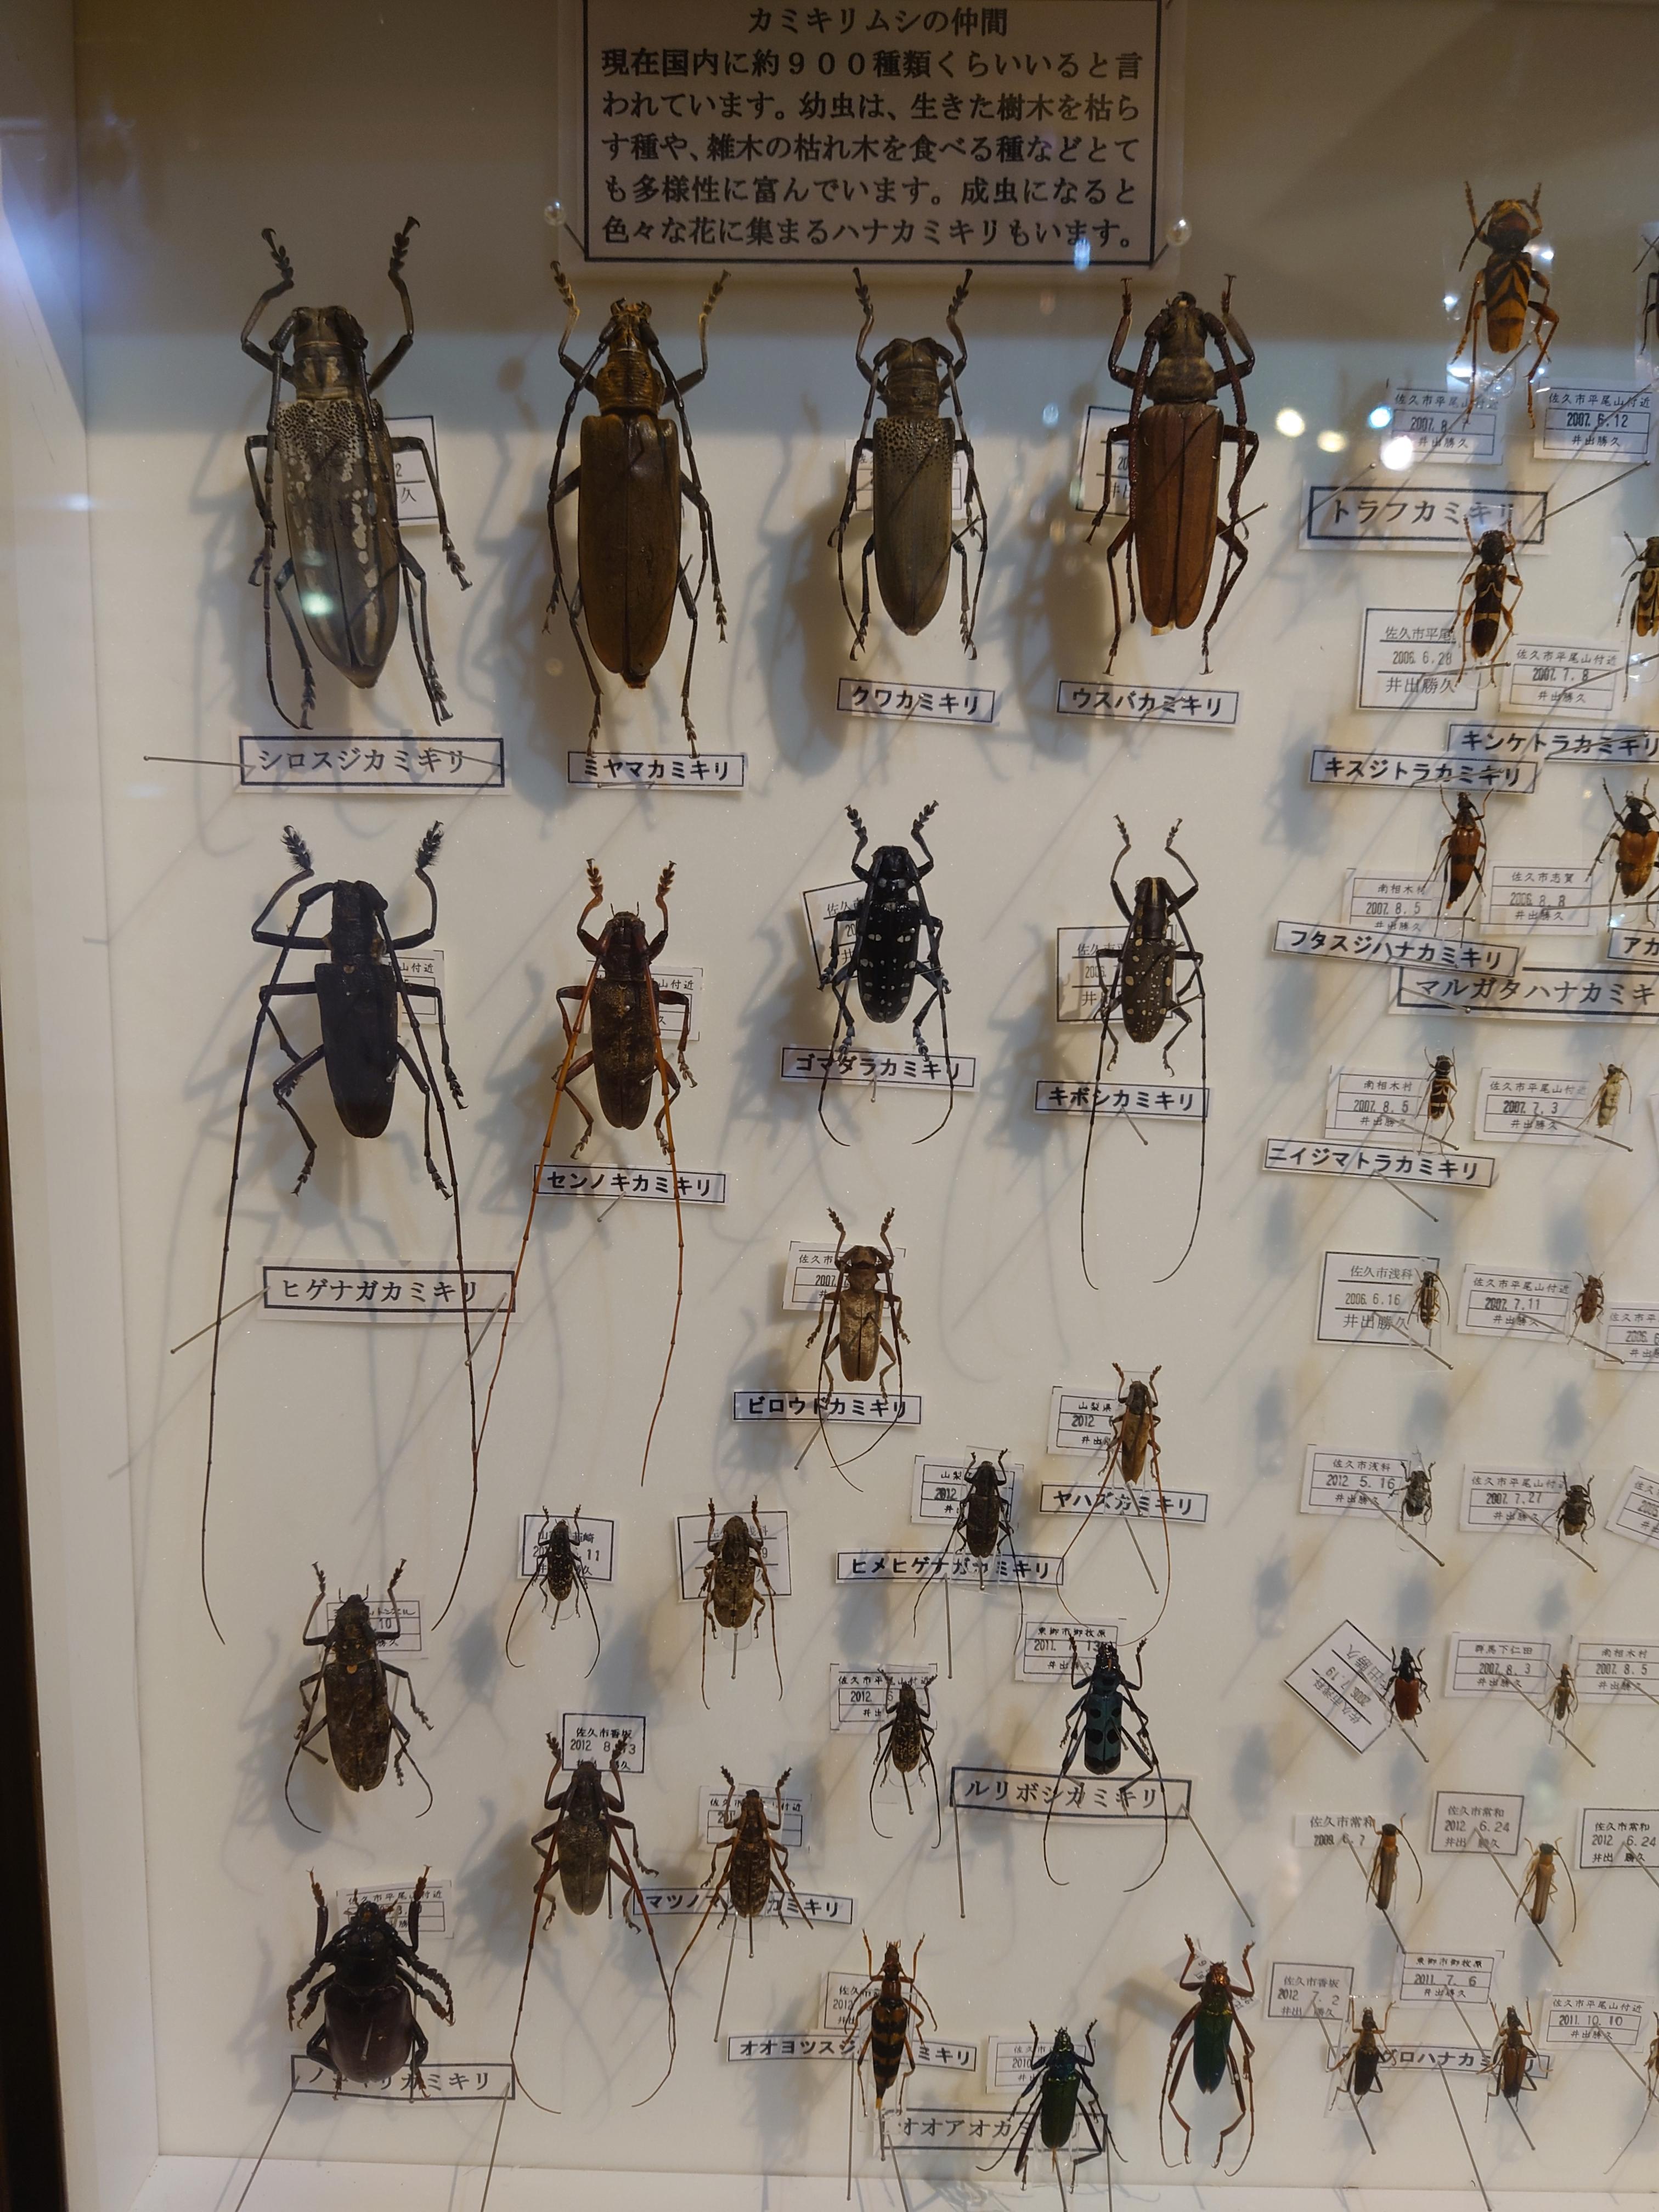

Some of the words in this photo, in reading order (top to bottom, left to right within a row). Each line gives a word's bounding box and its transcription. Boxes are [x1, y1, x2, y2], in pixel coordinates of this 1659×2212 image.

[749, 7, 1008, 36] カミキリムシの仲間
[602, 91, 1140, 123] われています。幼虫は、生きた樹木を枯ら
[602, 133, 1138, 165] す種や、雑木の枯れ木を食べる種などとて
[604, 175, 1136, 206] も多様性に富んでいます。成虫になると
[1334, 499, 1515, 526] トラフカミキリ
[1385, 627, 1455, 641] 佐久市平尾
[1386, 676, 1455, 695] 井出勝久
[851, 686, 979, 715] クワカミキリ
[1073, 689, 1222, 717] ウスバカミキリ
[1462, 731, 1659, 757] キンケトラカミキリ
[258, 748, 465, 774] シロスジカミキリ
[584, 755, 730, 781] ミヤマカミキリ
[1325, 757, 1521, 787] キスジトラカミキリ
[1290, 930, 1502, 969] フタスジハナカミキリ
[1624, 936, 1659, 956] アカ
[1416, 977, 1656, 1006] マルガタハナカミキ
[796, 1057, 961, 1081] ゴマダラカミキリ
[1049, 1088, 1194, 1111] キボシカミキリ
[1268, 1147, 1478, 1180] ニイジマトラカミキリ
[547, 1171, 712, 1197] センノキカミキリ
[283, 1278, 479, 1302] ヒゲナガカミキリ
[1473, 1277, 1570, 1294] 佐久市平尾山付近
[1344, 1314, 1409, 1330] 井出勝久
[1610, 1313, 1659, 1323] 佐久市平
[748, 1396, 910, 1419] ビロウドカミキリ
[1053, 1489, 1193, 1516] ヤハズカミキリ
[851, 1556, 1049, 1580] ヒメヒゲナガカミキリ
[964, 1779, 1157, 1808] ルリボシカミキリ
[646, 1894, 838, 1917] マツノマカミキリ
[1553, 1998, 1642, 2013] 佐久市平尾山付近
[740, 2039, 969, 2066] オオヨツスジミキリ
